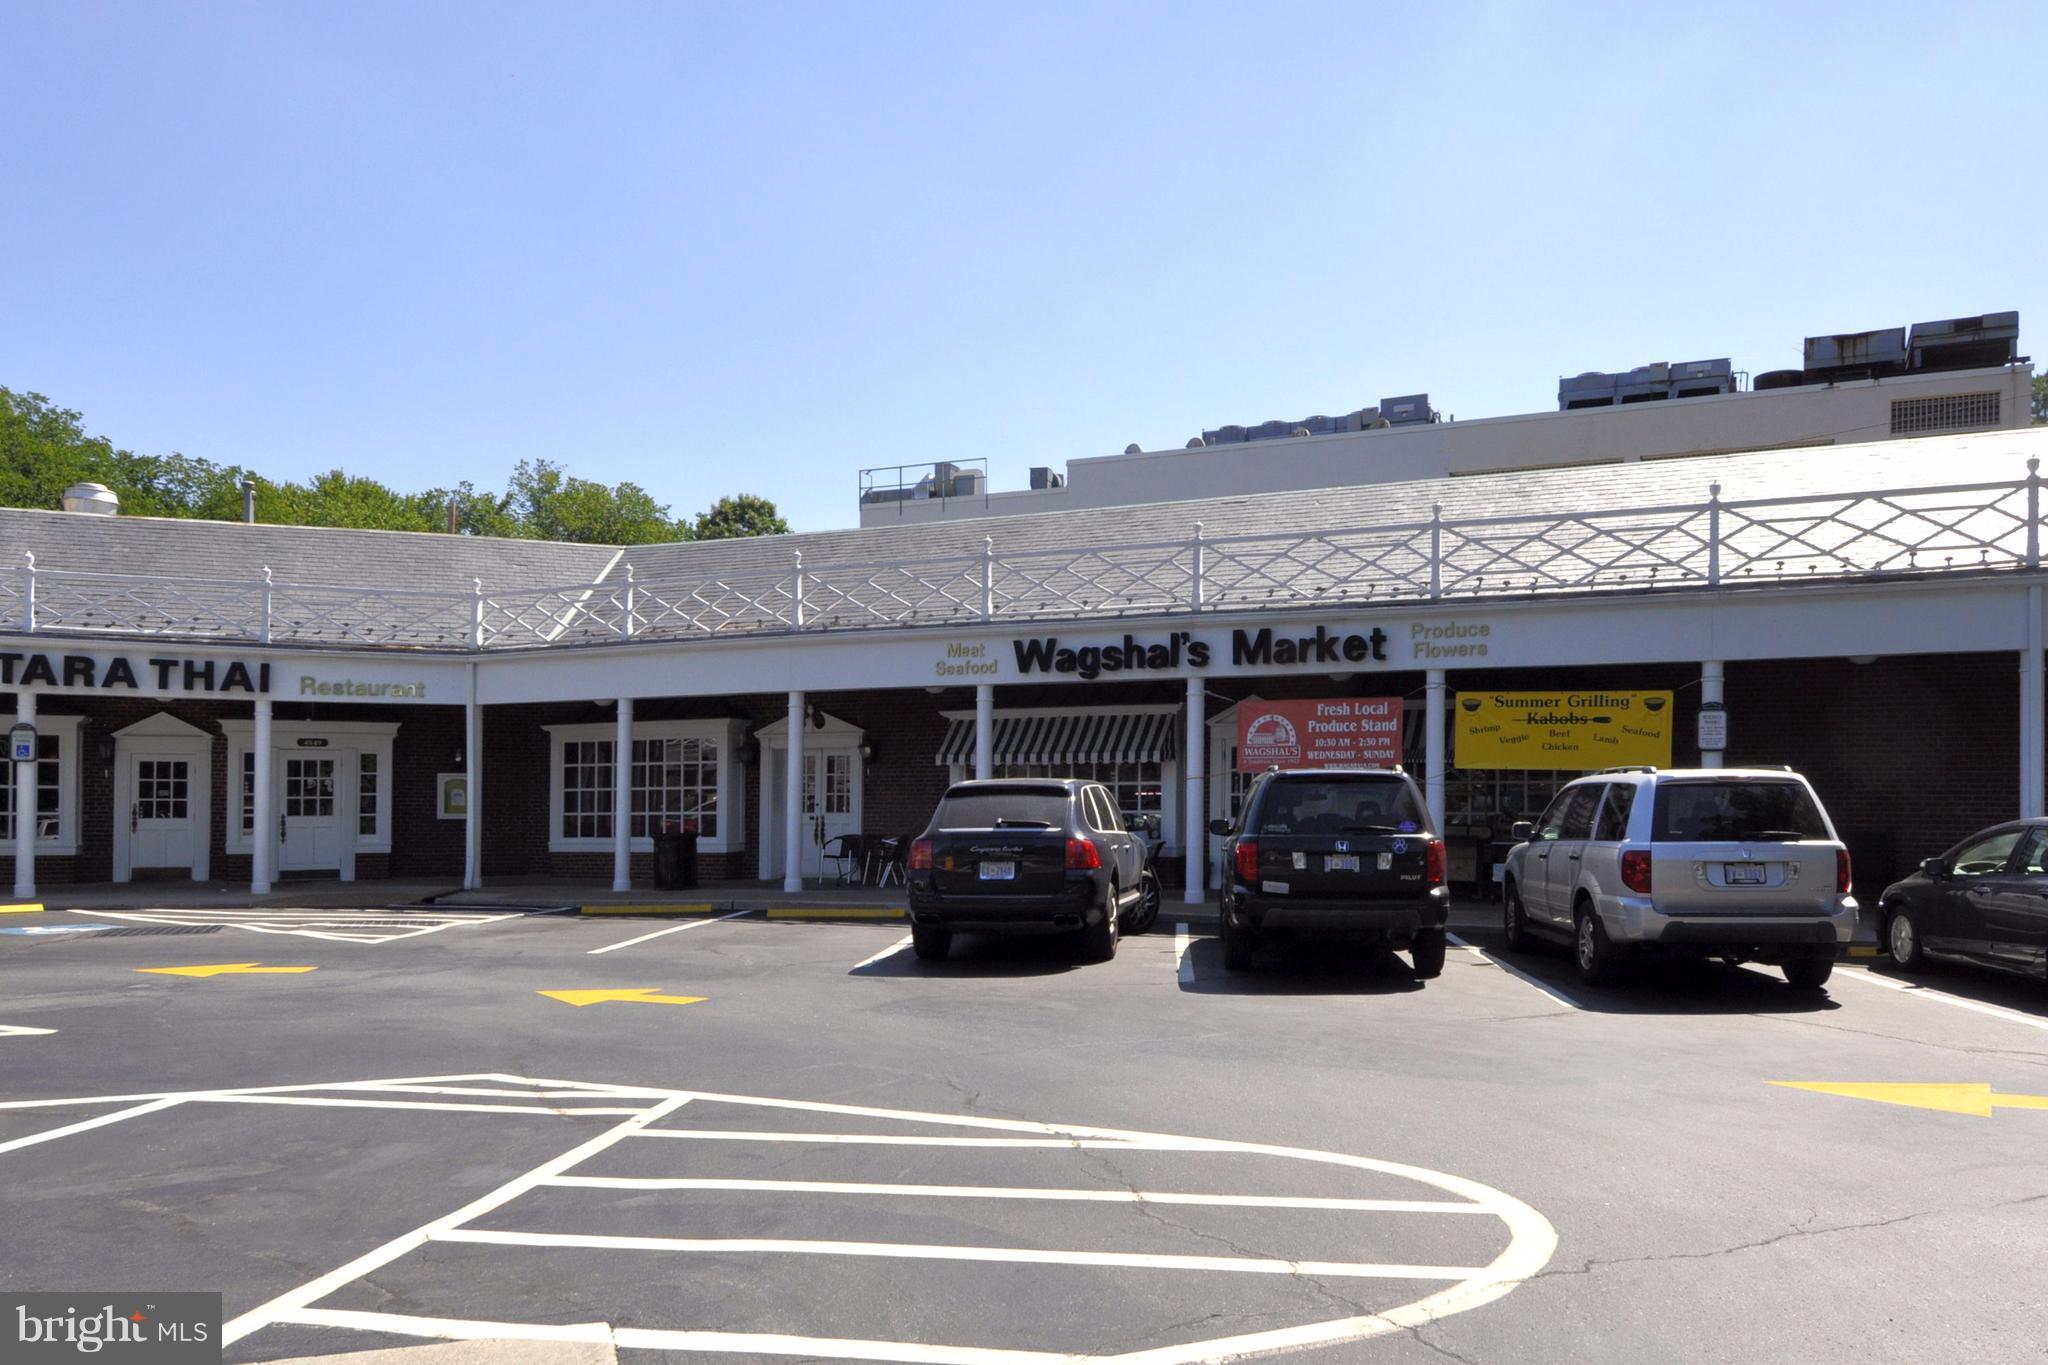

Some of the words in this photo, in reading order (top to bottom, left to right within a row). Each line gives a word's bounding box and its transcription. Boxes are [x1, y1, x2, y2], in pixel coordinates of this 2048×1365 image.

[1411, 621, 1490, 640] Produce
[946, 641, 986, 658] Meat
[1012, 632, 1210, 679] Wagshal's
[1232, 625, 1388, 666] Market
[1412, 641, 1489, 659] Flowers
[0, 653, 139, 688] TARA
[149, 658, 271, 693] THAI
[936, 659, 999, 677] Seafood
[300, 675, 427, 699] Restaurant
[1317, 703, 1350, 716] Fresh
[1355, 702, 1388, 715] Local
[1527, 711, 1589, 725] Kabobs
[1308, 719, 1357, 733] Produce
[1360, 718, 1398, 732] Stand
[1468, 724, 1502, 736] Shrimp
[1621, 725, 1661, 739] Seafood
[1498, 733, 1530, 746] Veggie
[1549, 729, 1571, 738] Beef
[1592, 733, 1620, 746] Lamb
[1315, 738, 1338, 747] 10:30
[1339, 738, 1351, 747] AM
[1359, 737, 1377, 747] 2:30
[1378, 737, 1391, 746] PM
[1541, 742, 1580, 752] Chicken
[1244, 746, 1299, 756] WAGSHAL'S
[1307, 750, 1356, 760] WEDNESDAY
[1363, 749, 1396, 759] SUNDAY
